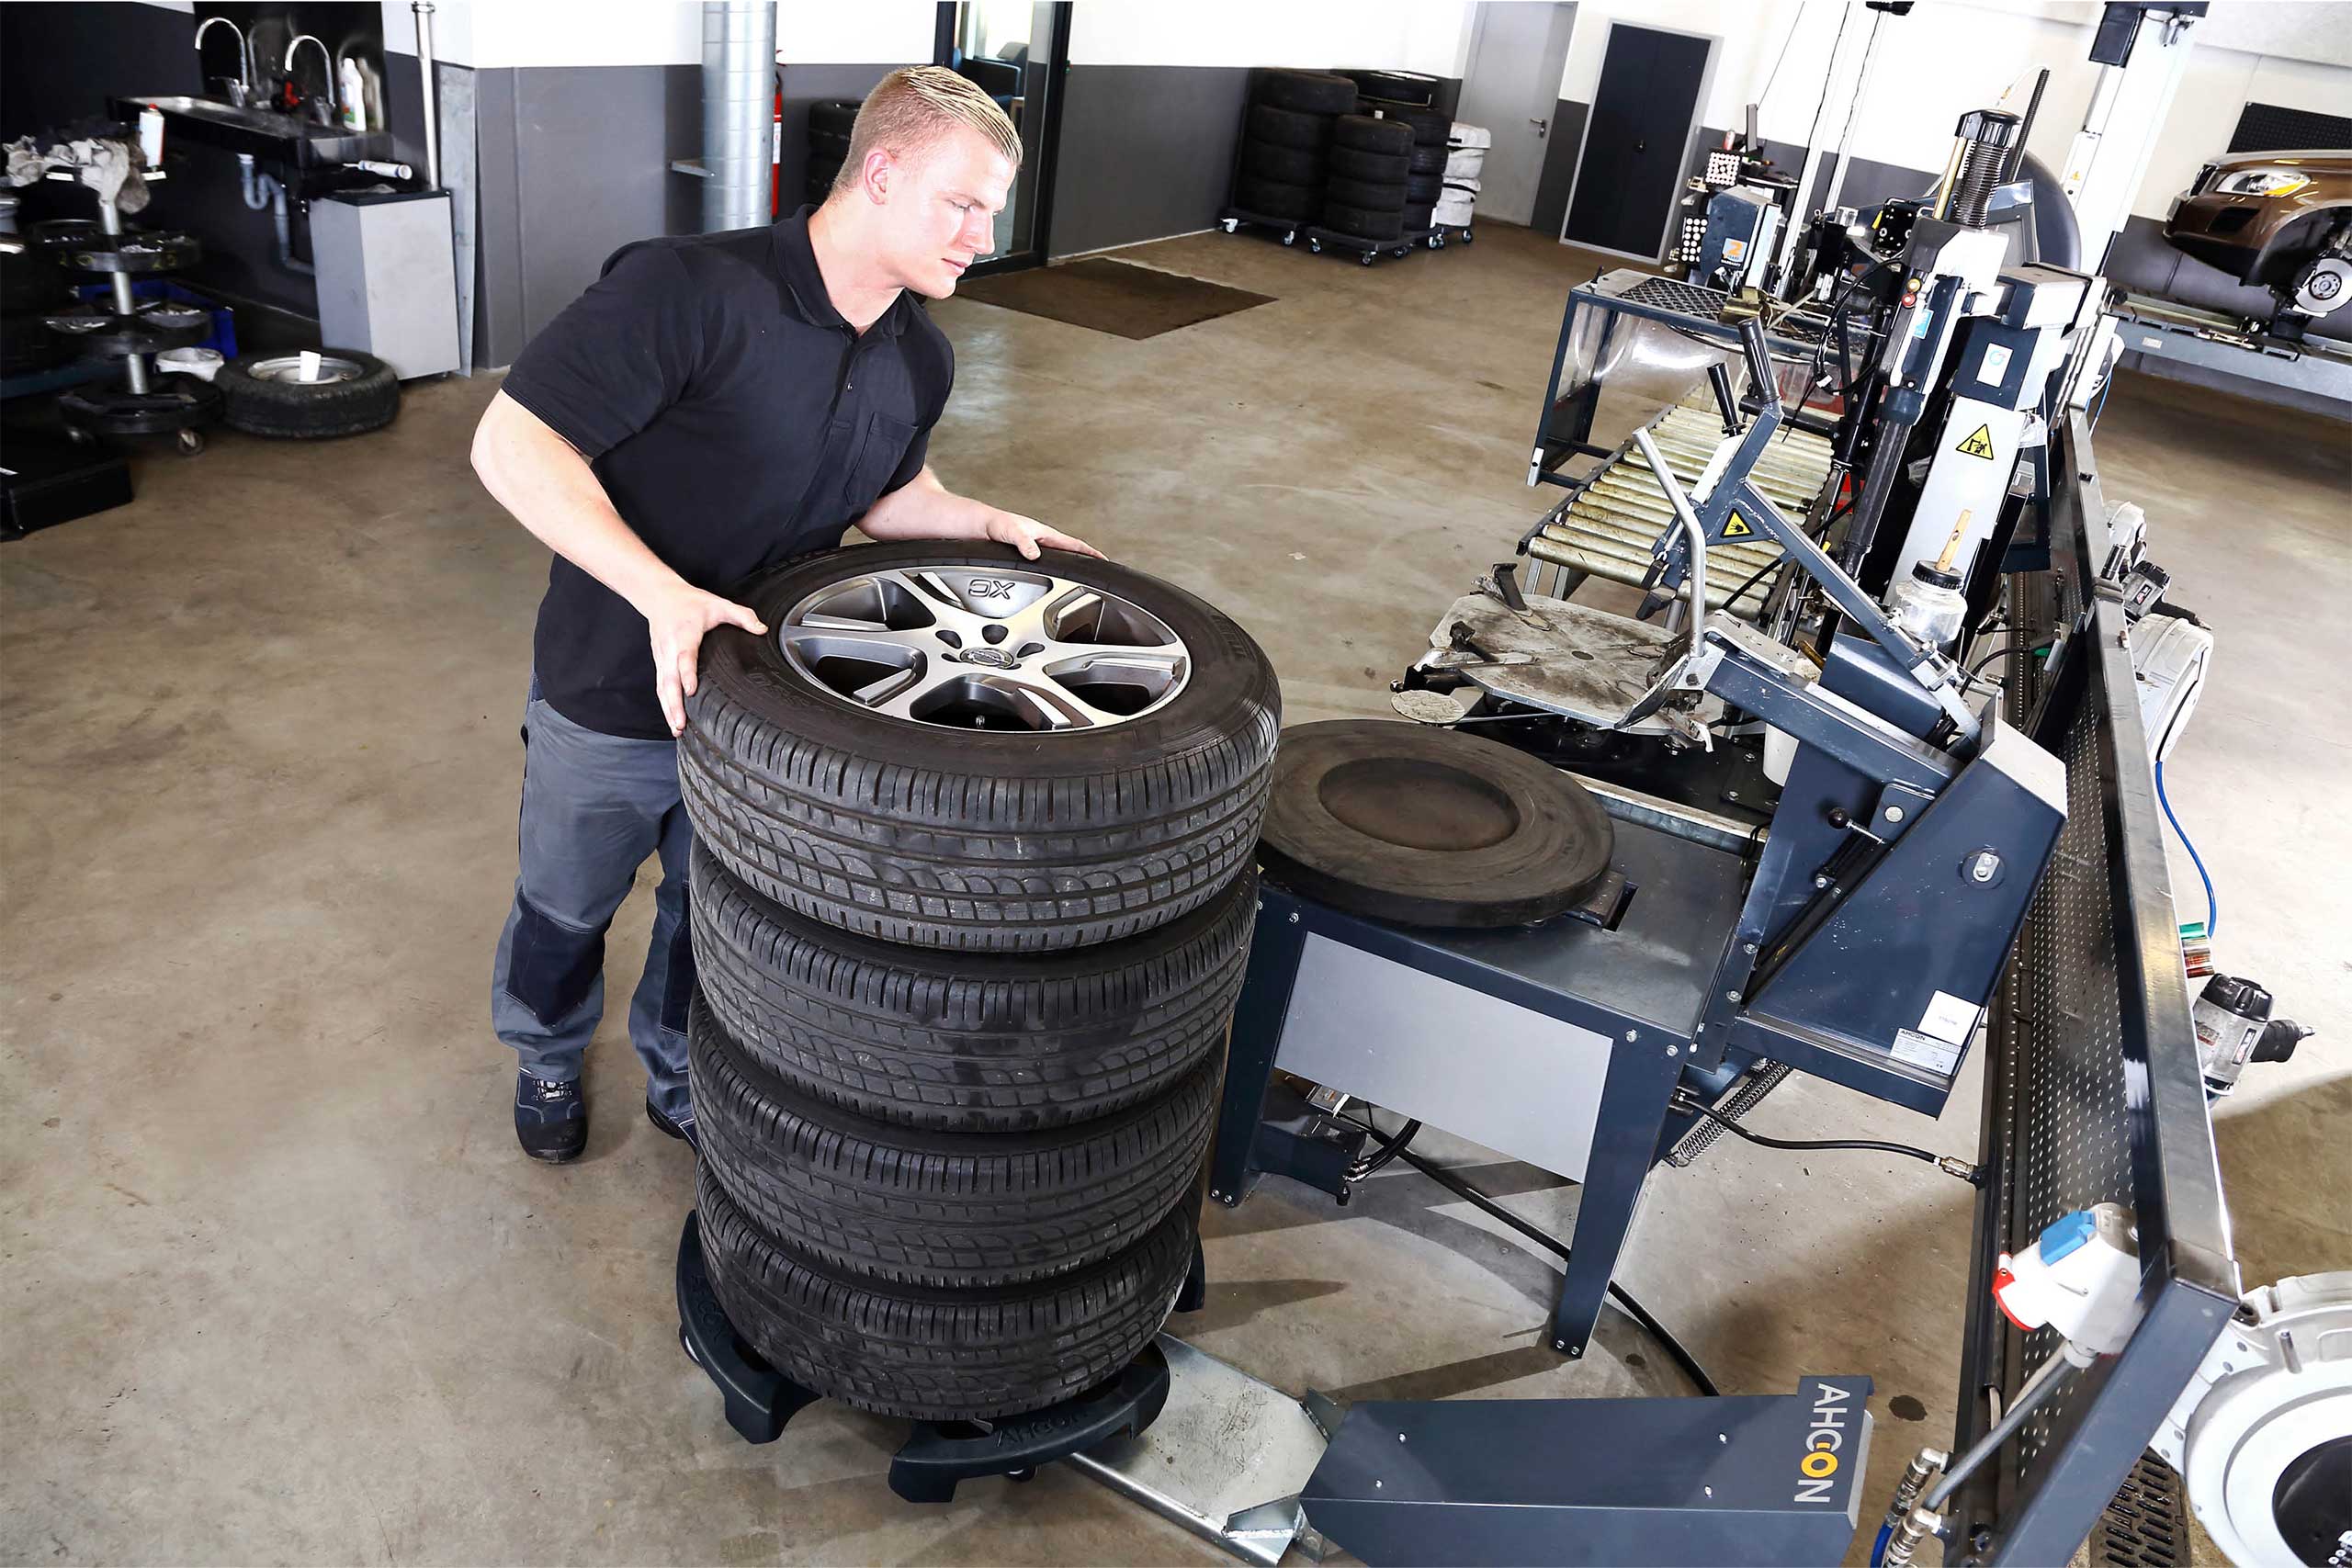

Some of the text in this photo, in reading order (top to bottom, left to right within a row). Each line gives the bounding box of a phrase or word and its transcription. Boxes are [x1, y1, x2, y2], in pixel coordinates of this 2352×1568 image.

[1727, 240, 1744, 256] 2
[1900, 1029, 1926, 1041] AHCON
[1793, 1382, 1851, 1503] AHCON
